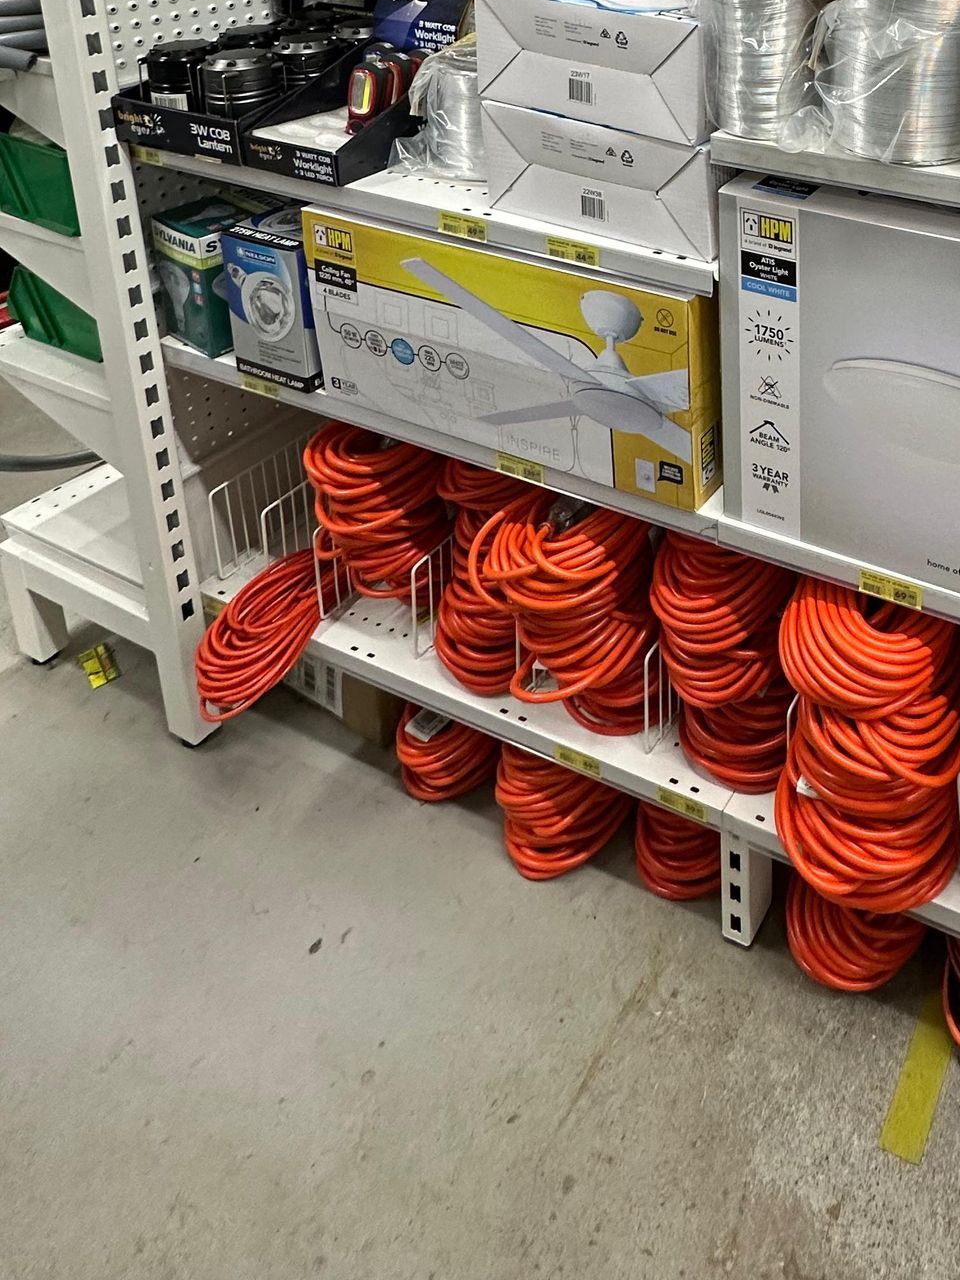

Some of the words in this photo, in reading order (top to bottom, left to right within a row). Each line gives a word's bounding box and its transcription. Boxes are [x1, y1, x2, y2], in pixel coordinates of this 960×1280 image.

[415, 29, 455, 43] Worklight
[189, 123, 208, 137] 3W
[209, 126, 230, 141] COB
[197, 136, 233, 154] Lantern
[293, 158, 333, 174] Worklight
[761, 217, 791, 242] HPM
[252, 231, 274, 243] HEAT
[273, 236, 299, 248] LAMP
[328, 230, 352, 252] HPM
[244, 251, 276, 263] NELSON
[761, 257, 775, 265] ATIS
[321, 265, 339, 276] Ceiling
[340, 269, 351, 278] Fan
[749, 262, 771, 271] Oyster
[772, 267, 788, 276] Light
[328, 289, 351, 300] BLADES
[747, 282, 766, 291] COOL
[768, 287, 789, 296] WHITE
[754, 324, 784, 340] 1750
[287, 377, 304, 389] LAMP
[750, 437, 775, 449] ANGLE
[759, 432, 780, 443] BEAM
[504, 434, 561, 462] INSPIRE
[752, 463, 758, 472] 3
[760, 465, 789, 482] YEAR
[753, 473, 788, 488] WARRANTY
[926, 557, 951, 572] home
